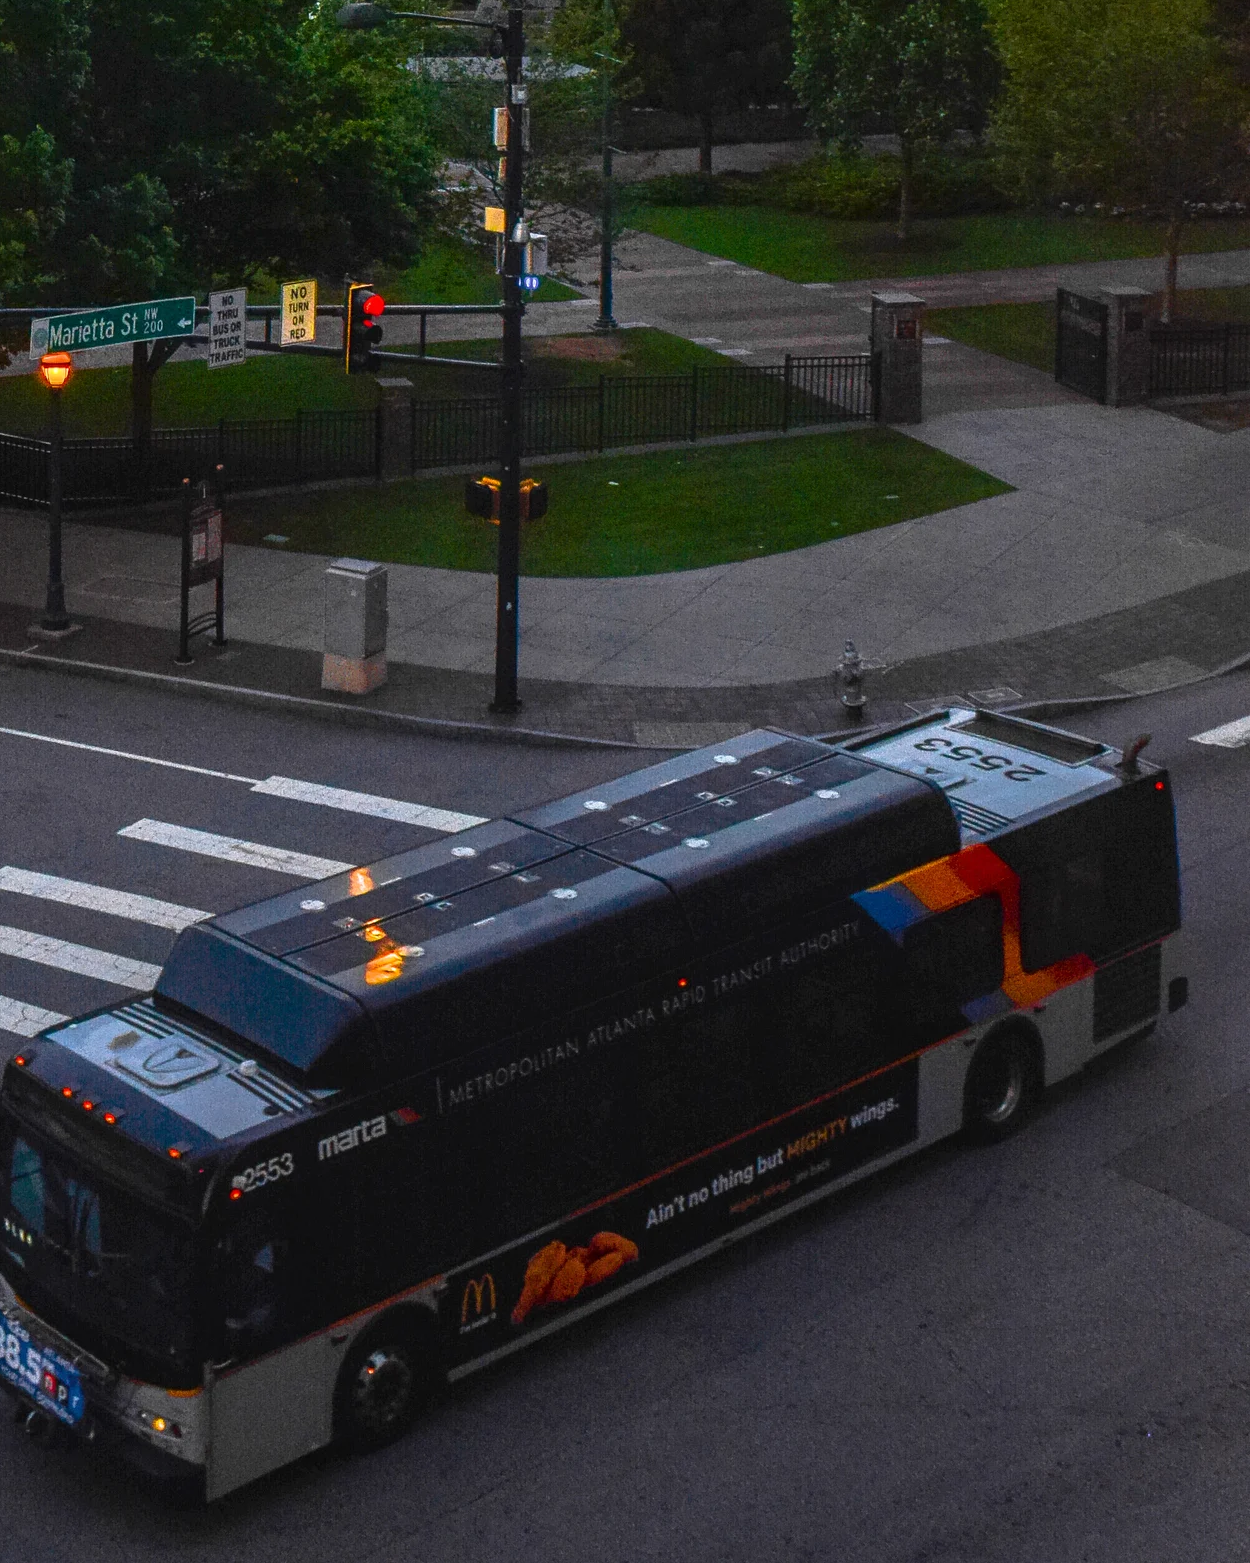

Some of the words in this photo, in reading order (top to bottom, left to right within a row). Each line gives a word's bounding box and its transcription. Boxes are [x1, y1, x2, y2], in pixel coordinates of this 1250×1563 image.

[222, 295, 234, 306] NO
[291, 287, 307, 299] NO
[144, 308, 159, 320] NW
[217, 308, 239, 320] THRU
[289, 301, 309, 314] TURN
[144, 319, 164, 334] 200
[213, 323, 230, 336] BUS
[230, 321, 241, 332] OR
[292, 316, 304, 326] ON
[50, 317, 115, 347] Marietta
[121, 312, 138, 336] St
[290, 328, 306, 340] RED
[214, 335, 240, 350] TRUCK
[211, 348, 244, 364] TRAFFIC
[914, 738, 1047, 782] 2553
[449, 1038, 579, 1107] METROPOLITAN
[587, 1007, 655, 1048] ATLANTA
[662, 986, 706, 1015] RAPID
[712, 956, 772, 997] TRANSIT
[780, 920, 859, 966] AUTHORITY
[318, 1115, 387, 1161] marta
[646, 1195, 685, 1229] Ain't
[688, 1187, 709, 1208] no
[711, 1164, 755, 1197] thing
[757, 1148, 783, 1175] but
[787, 1116, 848, 1160] MIGHTY
[850, 1097, 899, 1129] wings.
[243, 1152, 294, 1193] 2553
